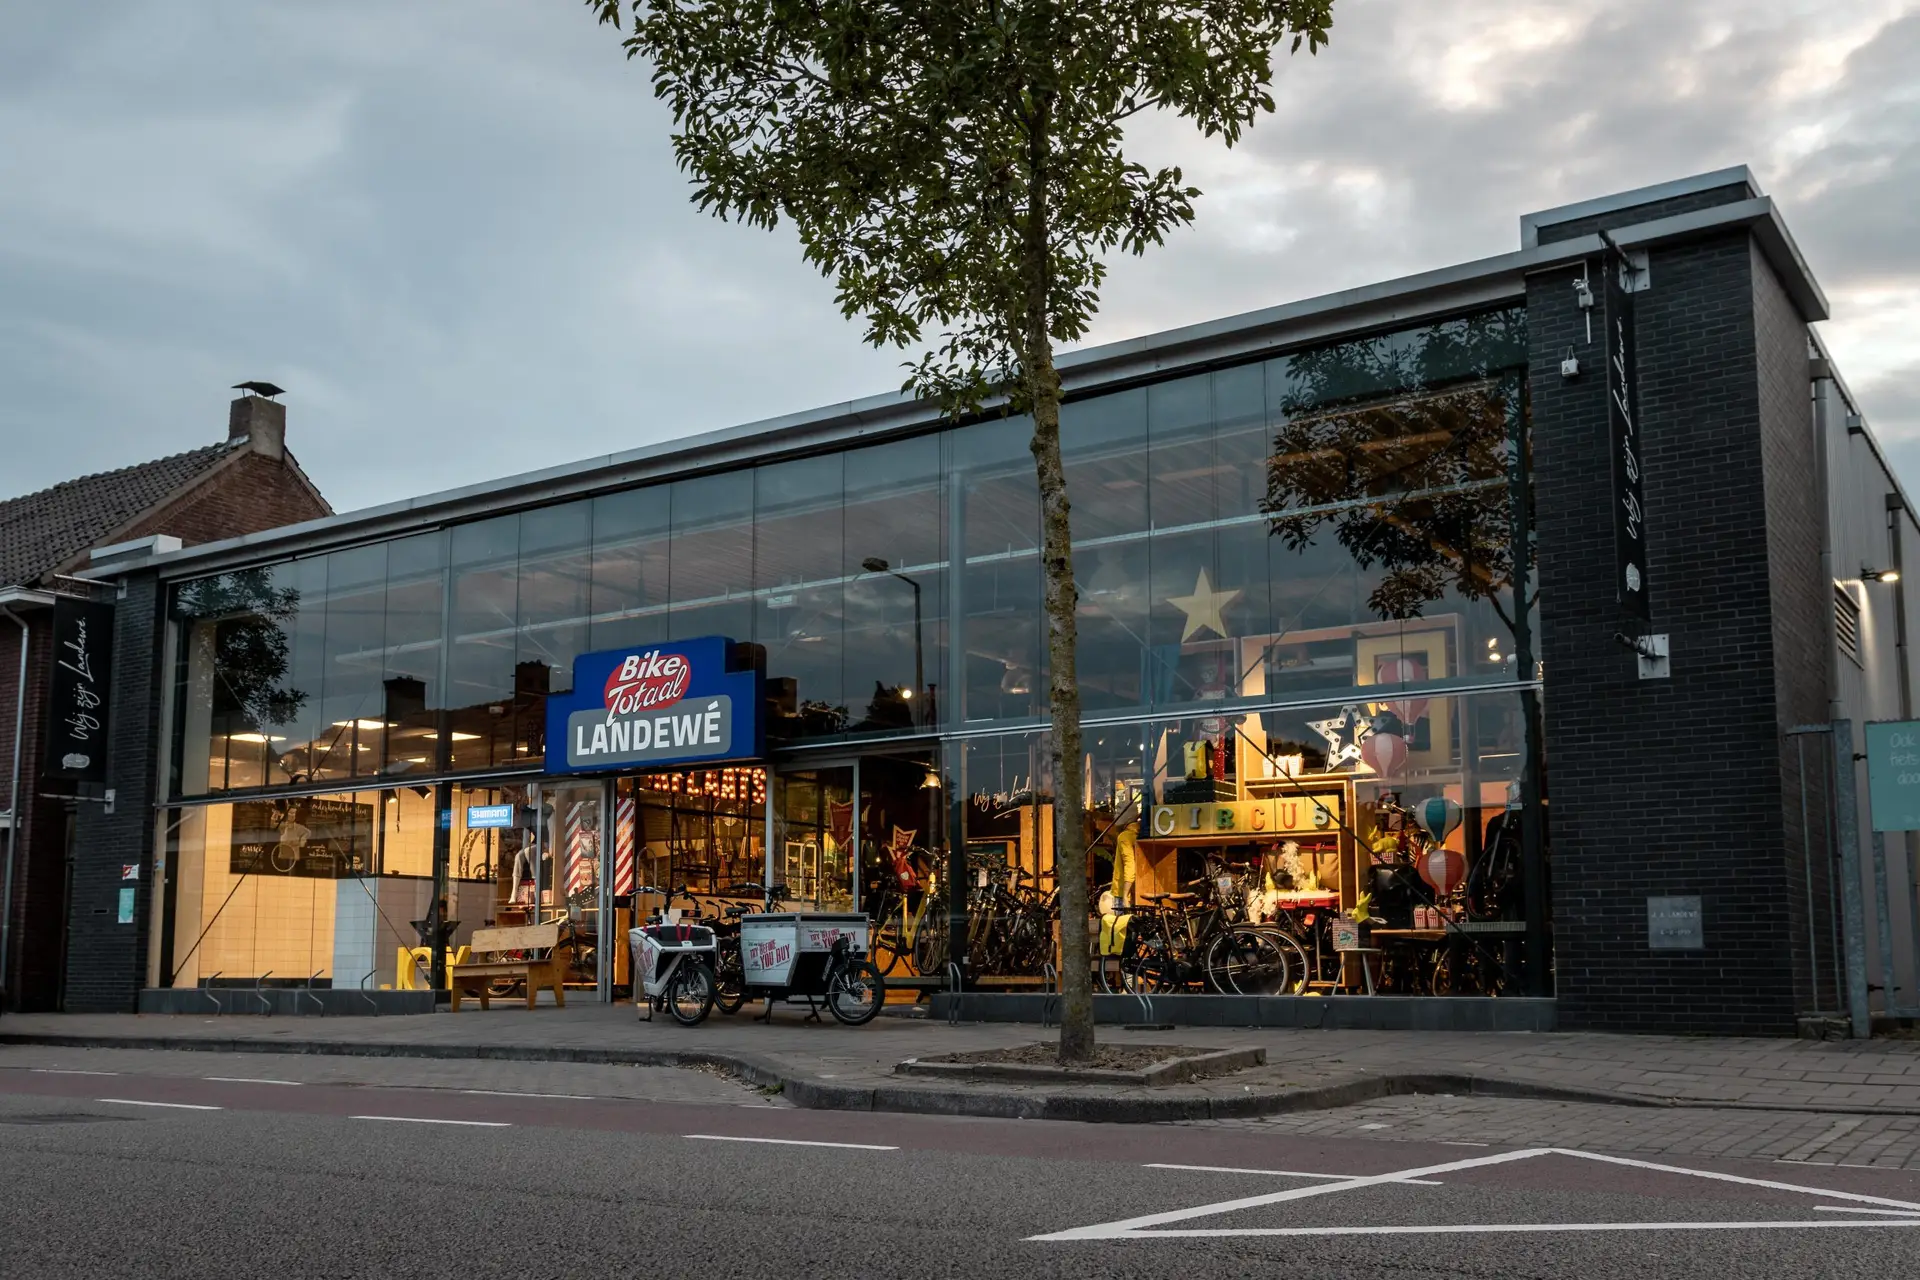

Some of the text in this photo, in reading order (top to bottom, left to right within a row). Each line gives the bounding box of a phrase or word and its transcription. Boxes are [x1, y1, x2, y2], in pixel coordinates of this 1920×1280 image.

[618, 650, 681, 682] Bike
[73, 683, 100, 709] zijn
[605, 664, 688, 728] Totaal
[65, 711, 99, 740] Wij
[576, 700, 721, 756] LANDEWÉ
[1008, 774, 1032, 803] Land
[471, 808, 508, 819] SHIMANO
[1154, 803, 1330, 836] CIRCUS
[821, 928, 840, 938] BEFORE
[750, 947, 758, 959] TRY
[759, 939, 776, 955] BEFORE
[760, 951, 774, 970] YOU
[776, 944, 790, 964] BUY
